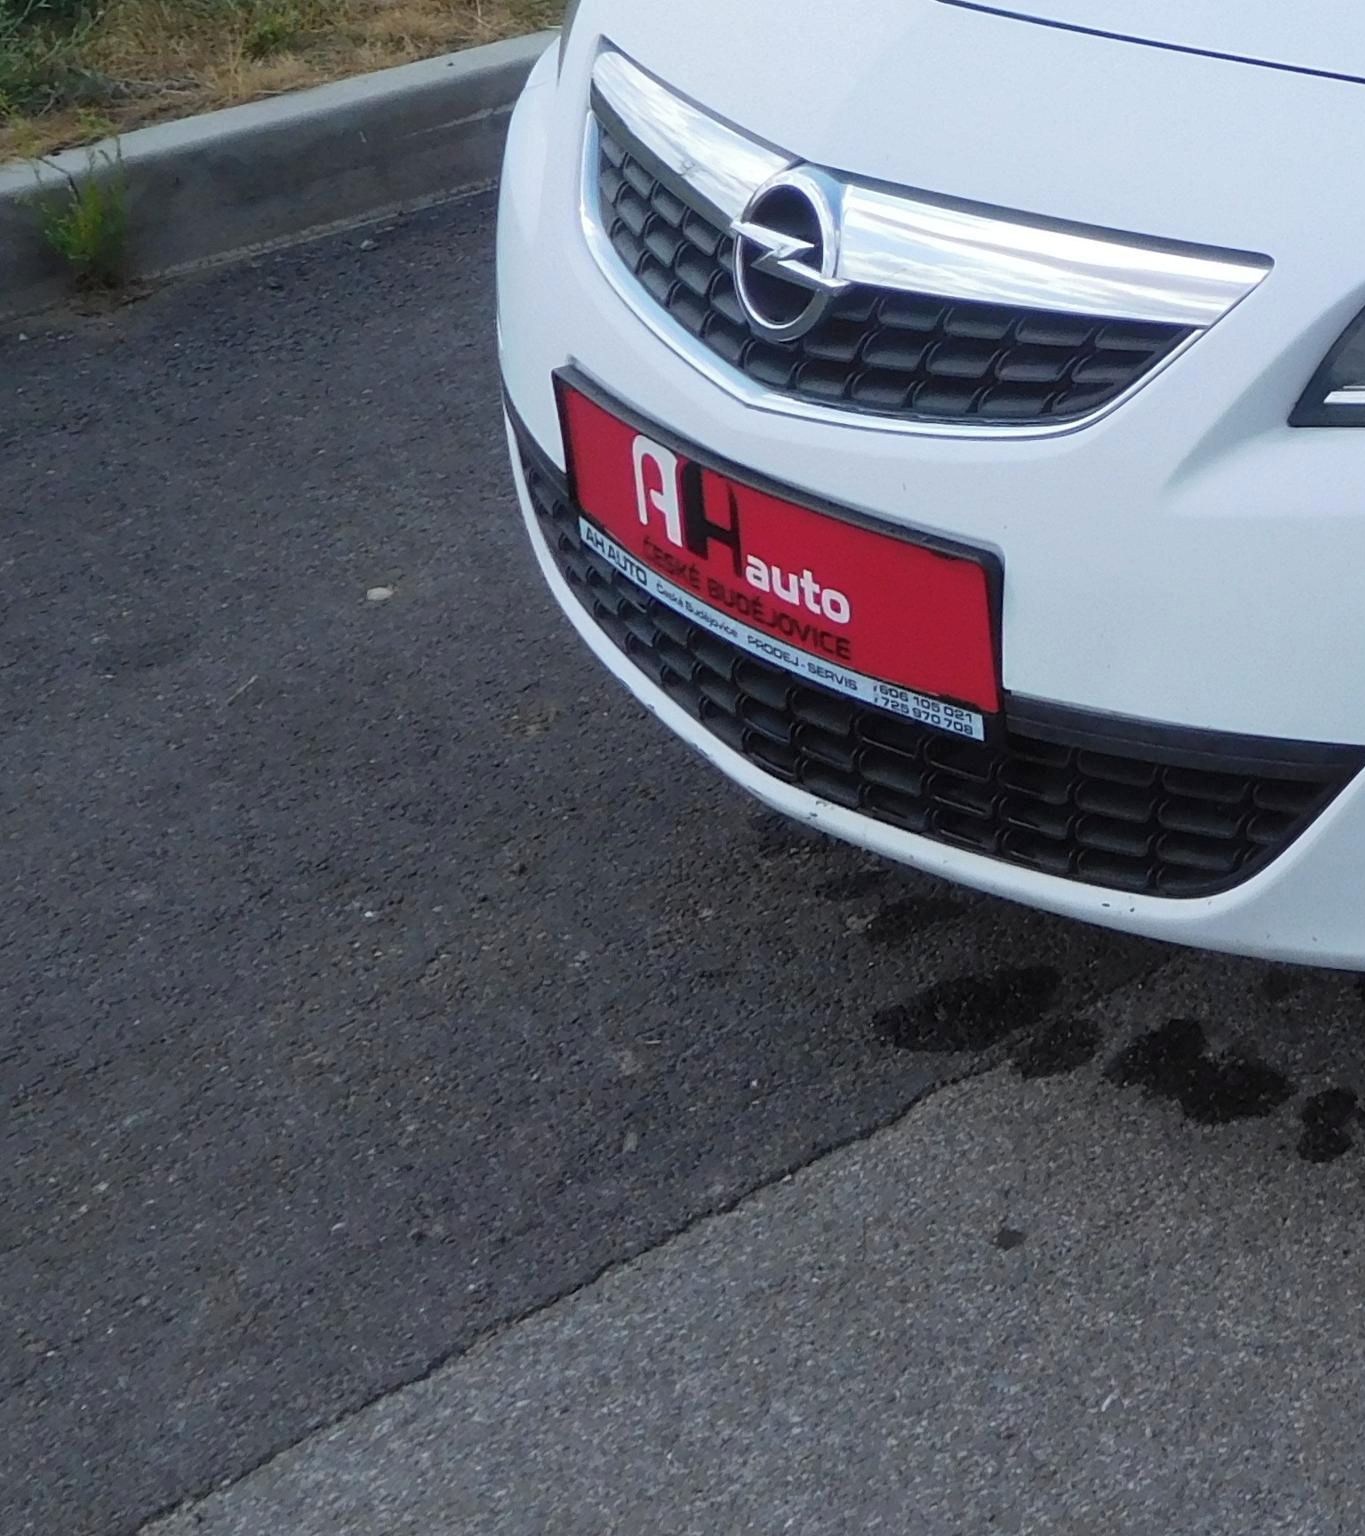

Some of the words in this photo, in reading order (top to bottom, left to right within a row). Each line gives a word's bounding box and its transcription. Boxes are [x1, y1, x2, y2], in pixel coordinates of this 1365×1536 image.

[586, 527, 605, 553] AH
[608, 543, 648, 586] AUTO
[808, 662, 858, 690] SERVIS
[745, 554, 850, 624] auto
[879, 684, 908, 702] 606
[913, 696, 941, 713] 105
[944, 703, 972, 723] 021
[881, 696, 909, 715] 725
[912, 707, 941, 725] 970
[944, 717, 973, 736] 708
